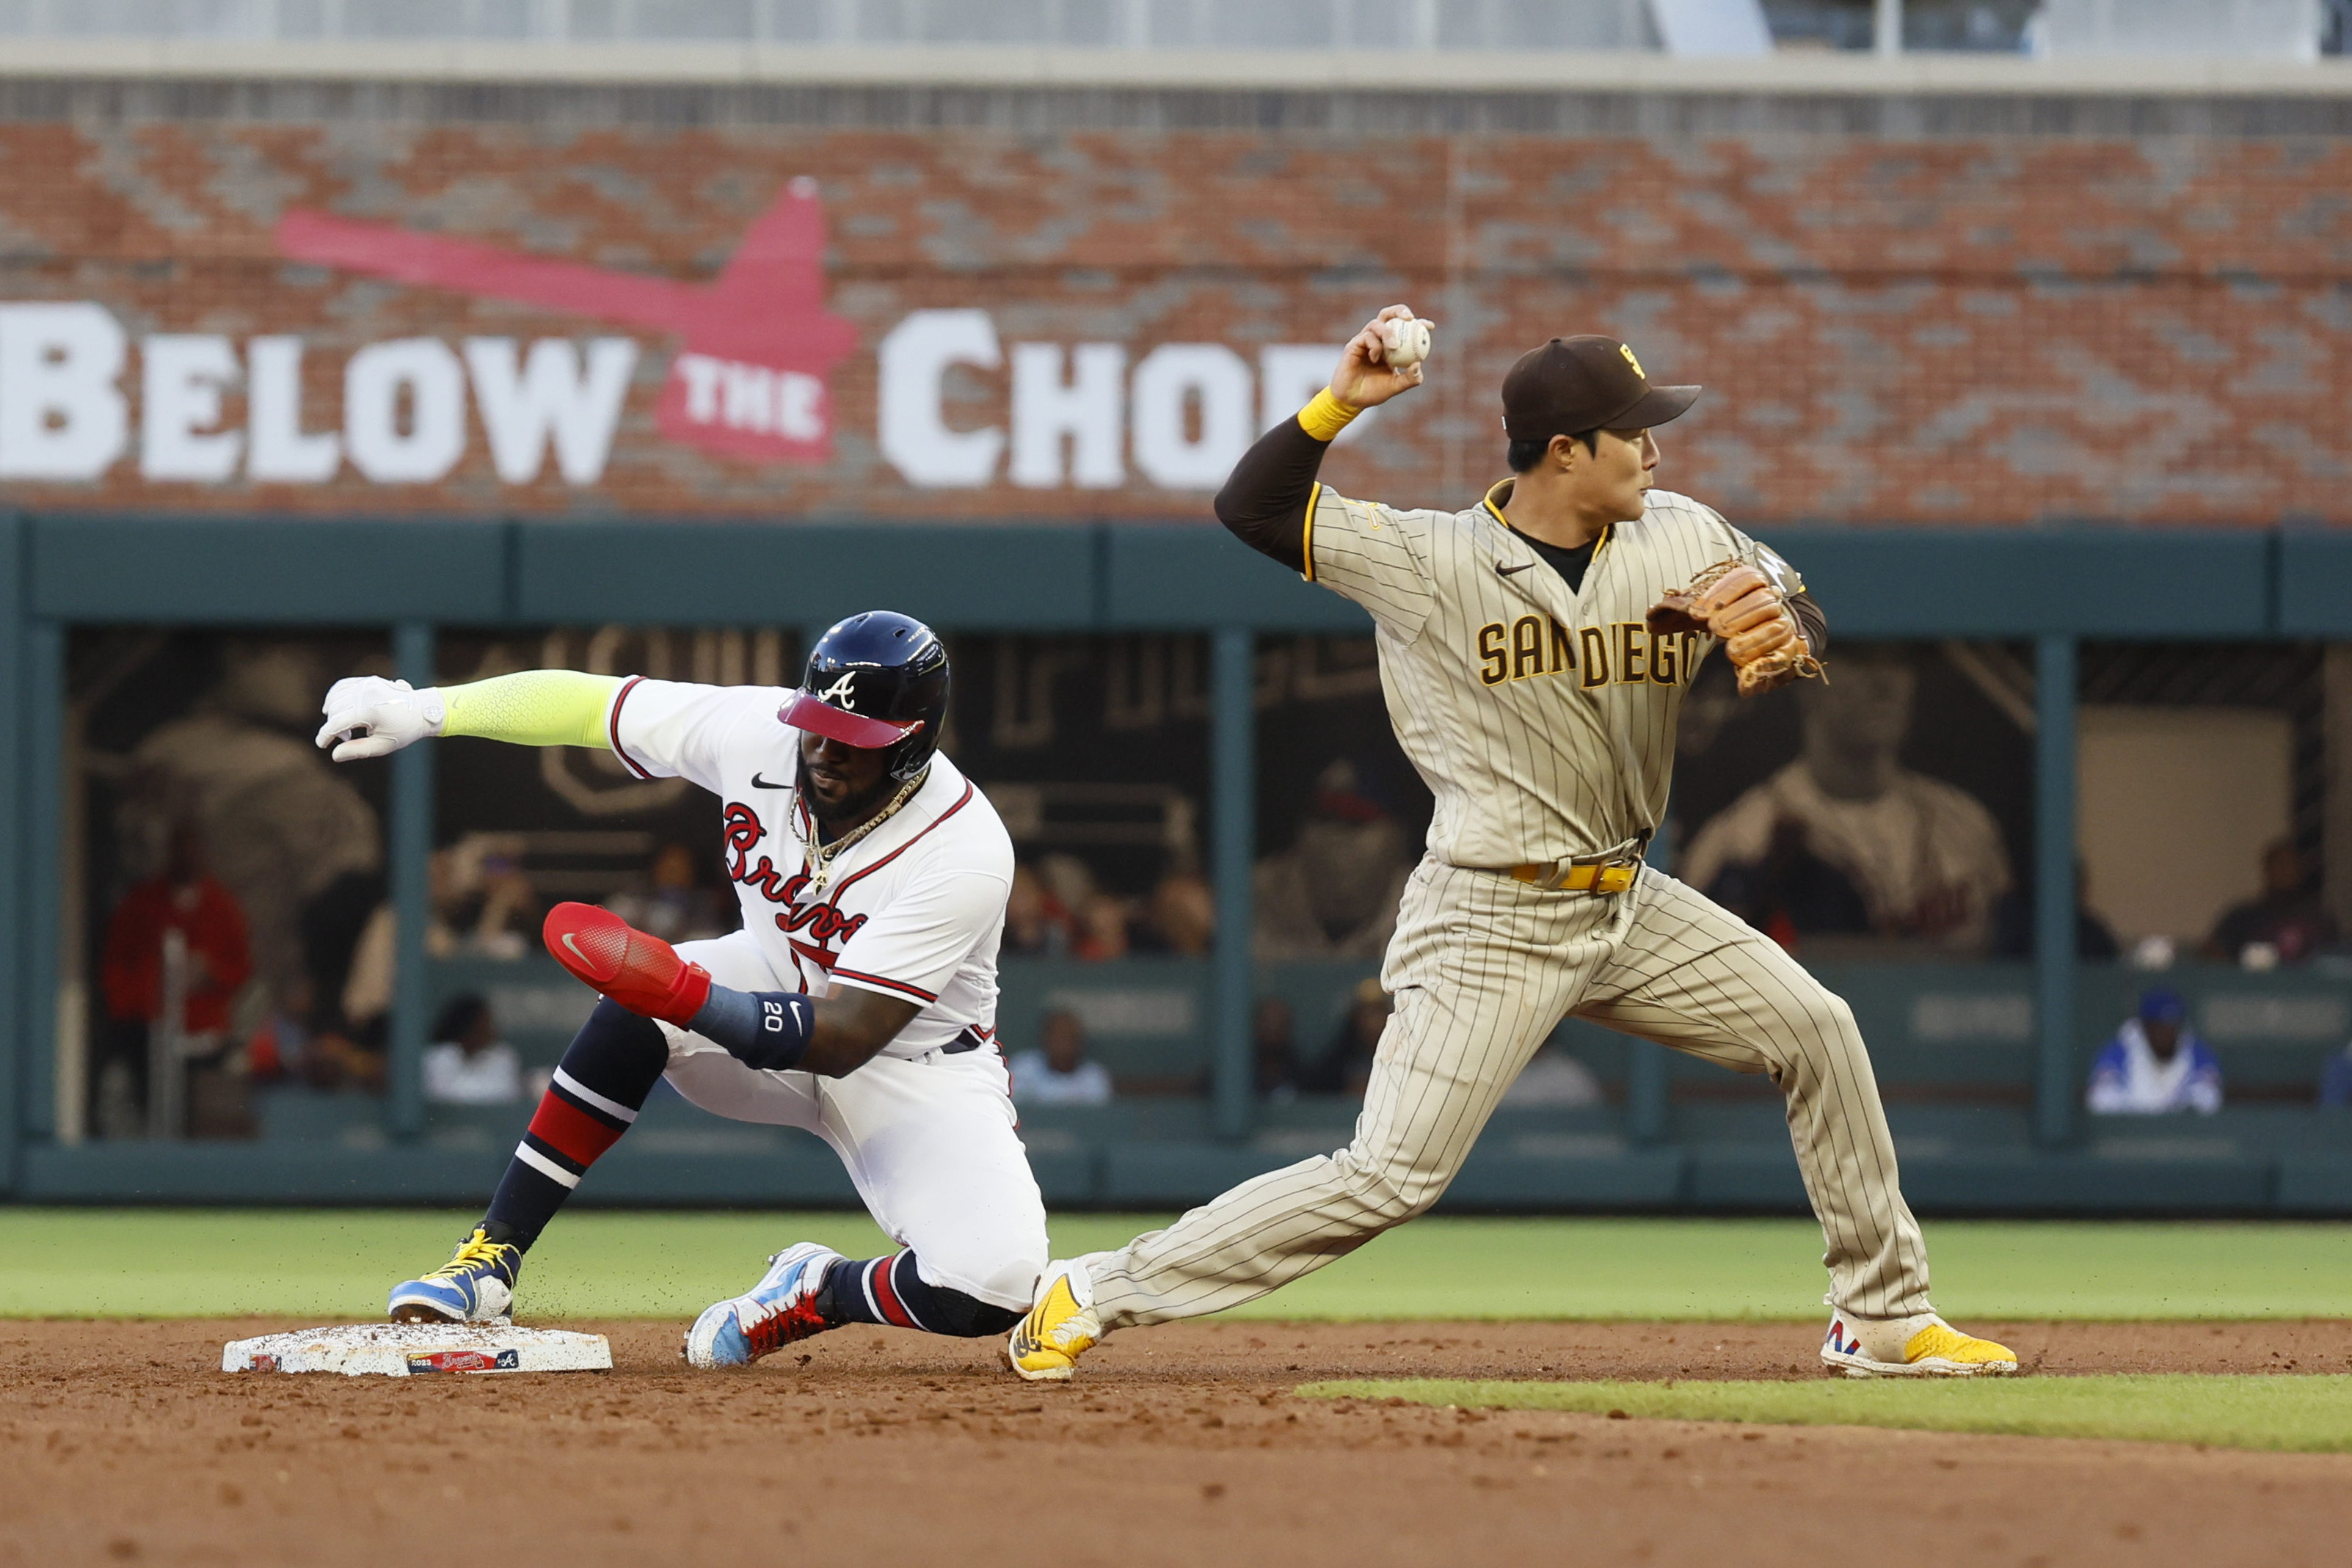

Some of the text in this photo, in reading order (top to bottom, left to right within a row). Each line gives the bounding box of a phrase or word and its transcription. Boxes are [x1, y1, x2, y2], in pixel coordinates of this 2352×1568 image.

[677, 353, 826, 443] THE
[818, 670, 856, 710] A
[763, 1000, 783, 1032] 20
